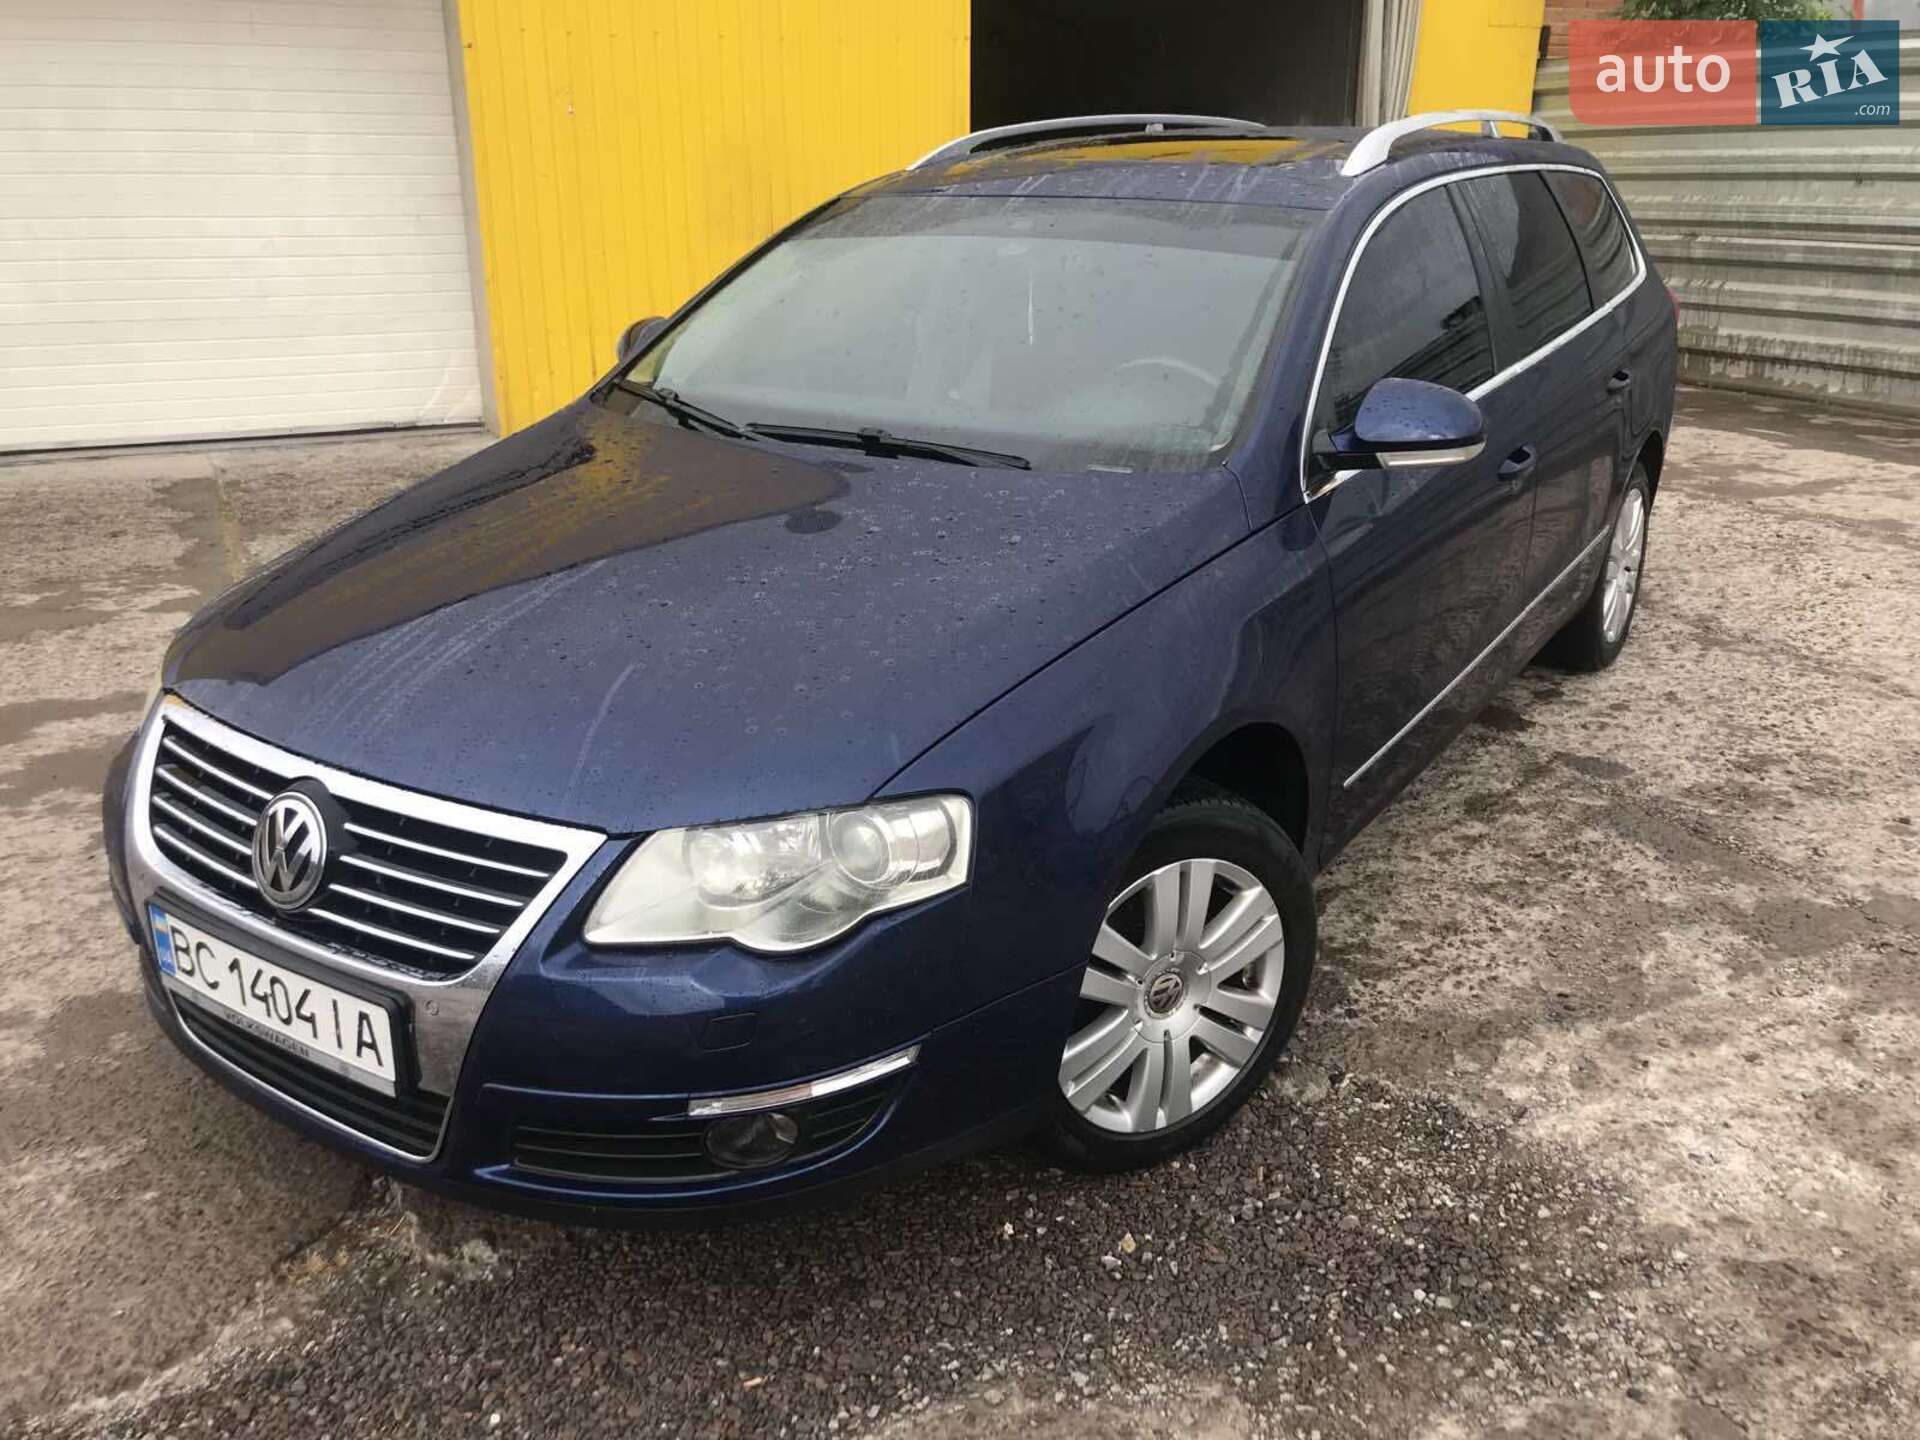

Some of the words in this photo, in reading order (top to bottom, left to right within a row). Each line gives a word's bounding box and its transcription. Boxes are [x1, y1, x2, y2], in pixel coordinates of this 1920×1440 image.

[170, 925, 220, 990] BC
[228, 957, 318, 1040] 1404
[331, 998, 384, 1067] IA
